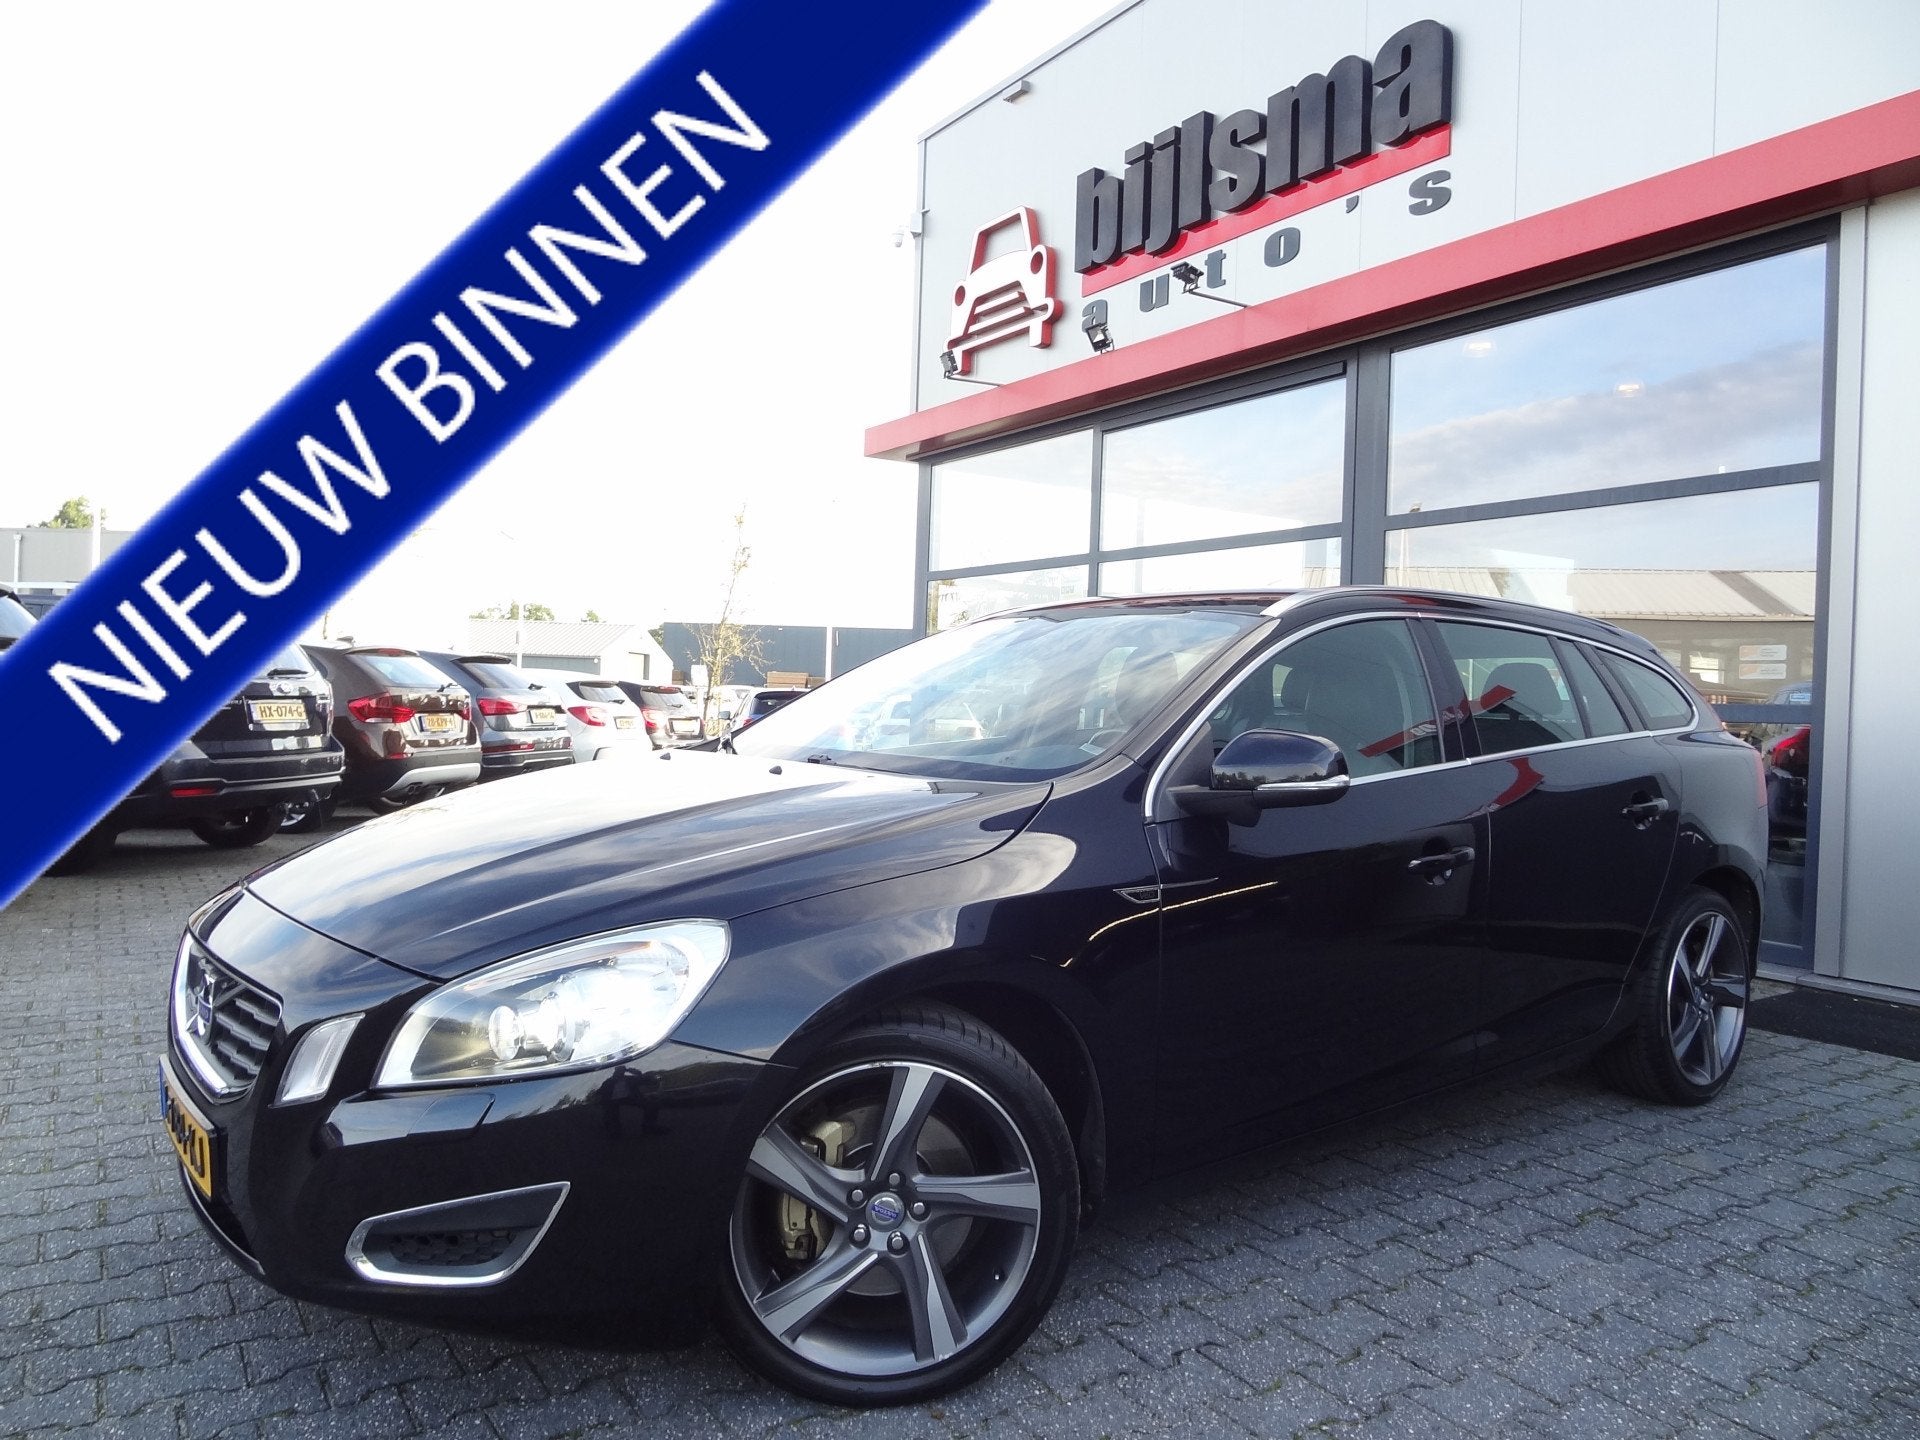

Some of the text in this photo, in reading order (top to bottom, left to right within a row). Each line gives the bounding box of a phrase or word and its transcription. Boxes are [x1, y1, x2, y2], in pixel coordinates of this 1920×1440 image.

[1074, 18, 1453, 273] bijlsma
[1082, 170, 1452, 333] auto's
[258, 705, 304, 718] HX-074-G
